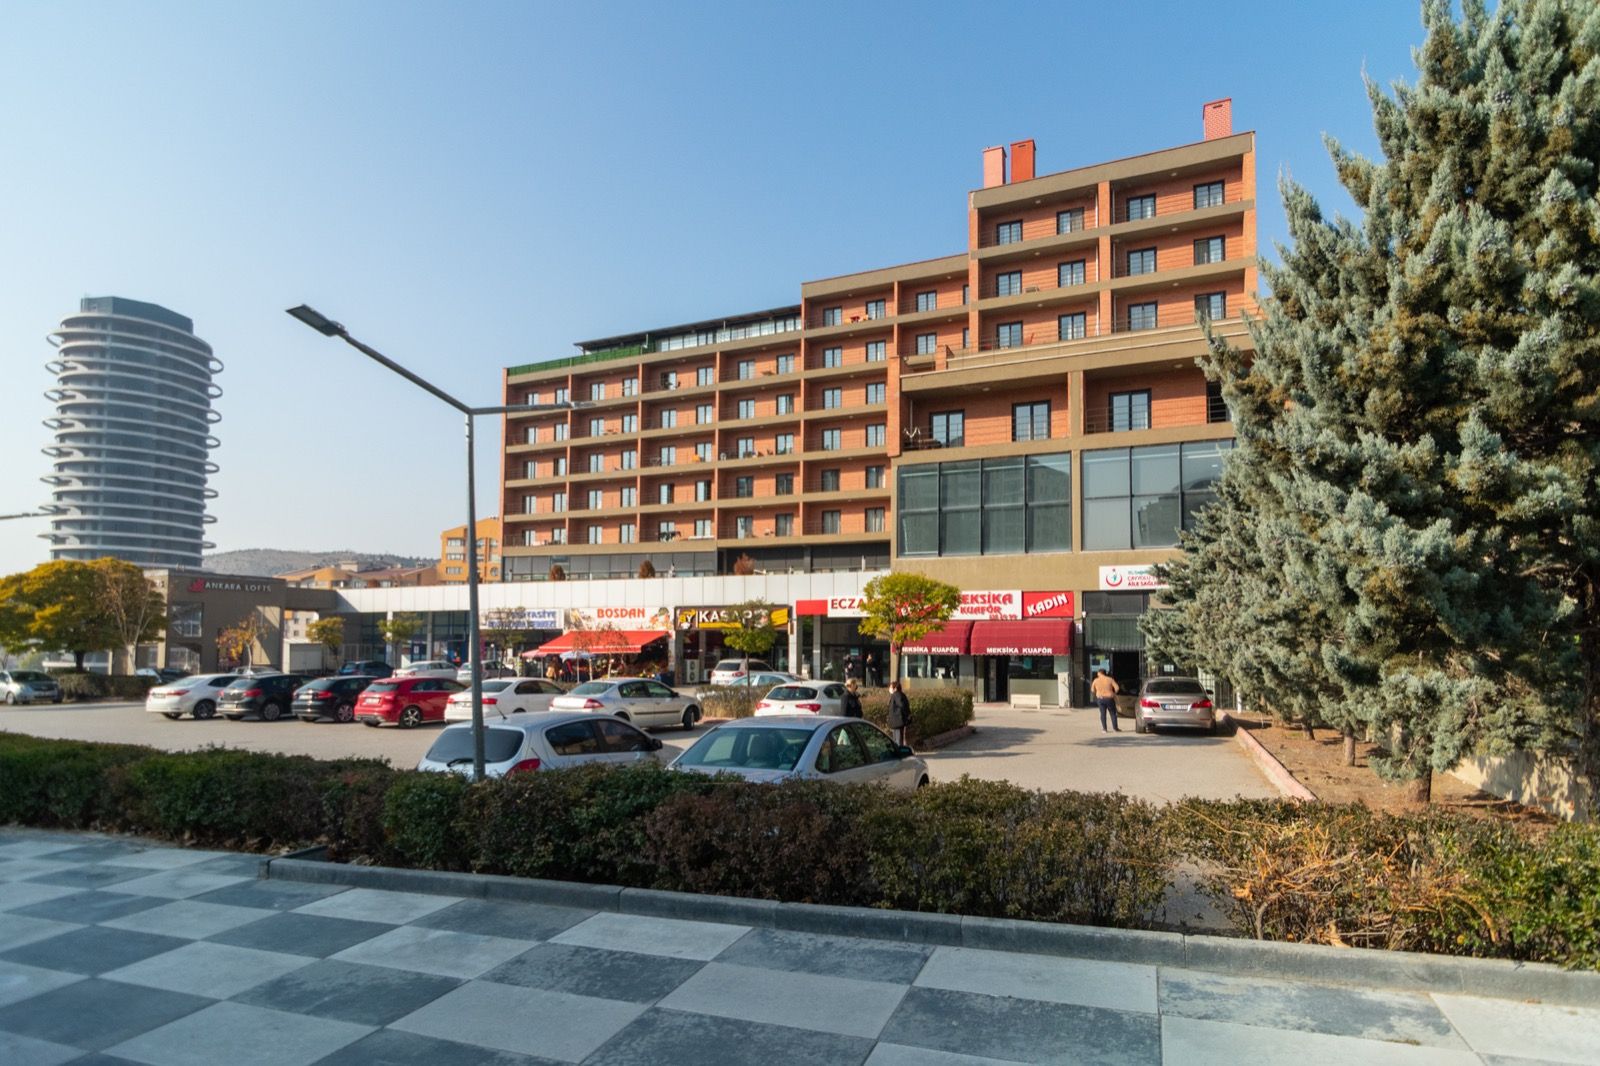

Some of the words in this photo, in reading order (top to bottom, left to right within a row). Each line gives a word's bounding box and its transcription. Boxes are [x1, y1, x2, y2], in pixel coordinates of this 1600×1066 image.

[205, 582, 242, 590] ANKARA
[245, 584, 272, 592] LOFTS
[957, 591, 1014, 605] EKSİKA
[1026, 593, 1069, 617] KADIN
[597, 607, 646, 619] BOSDAN
[931, 646, 960, 654] KUAFÖR
[986, 646, 1019, 655] MEKSİKA
[1022, 647, 1053, 655] KUAFÖR
